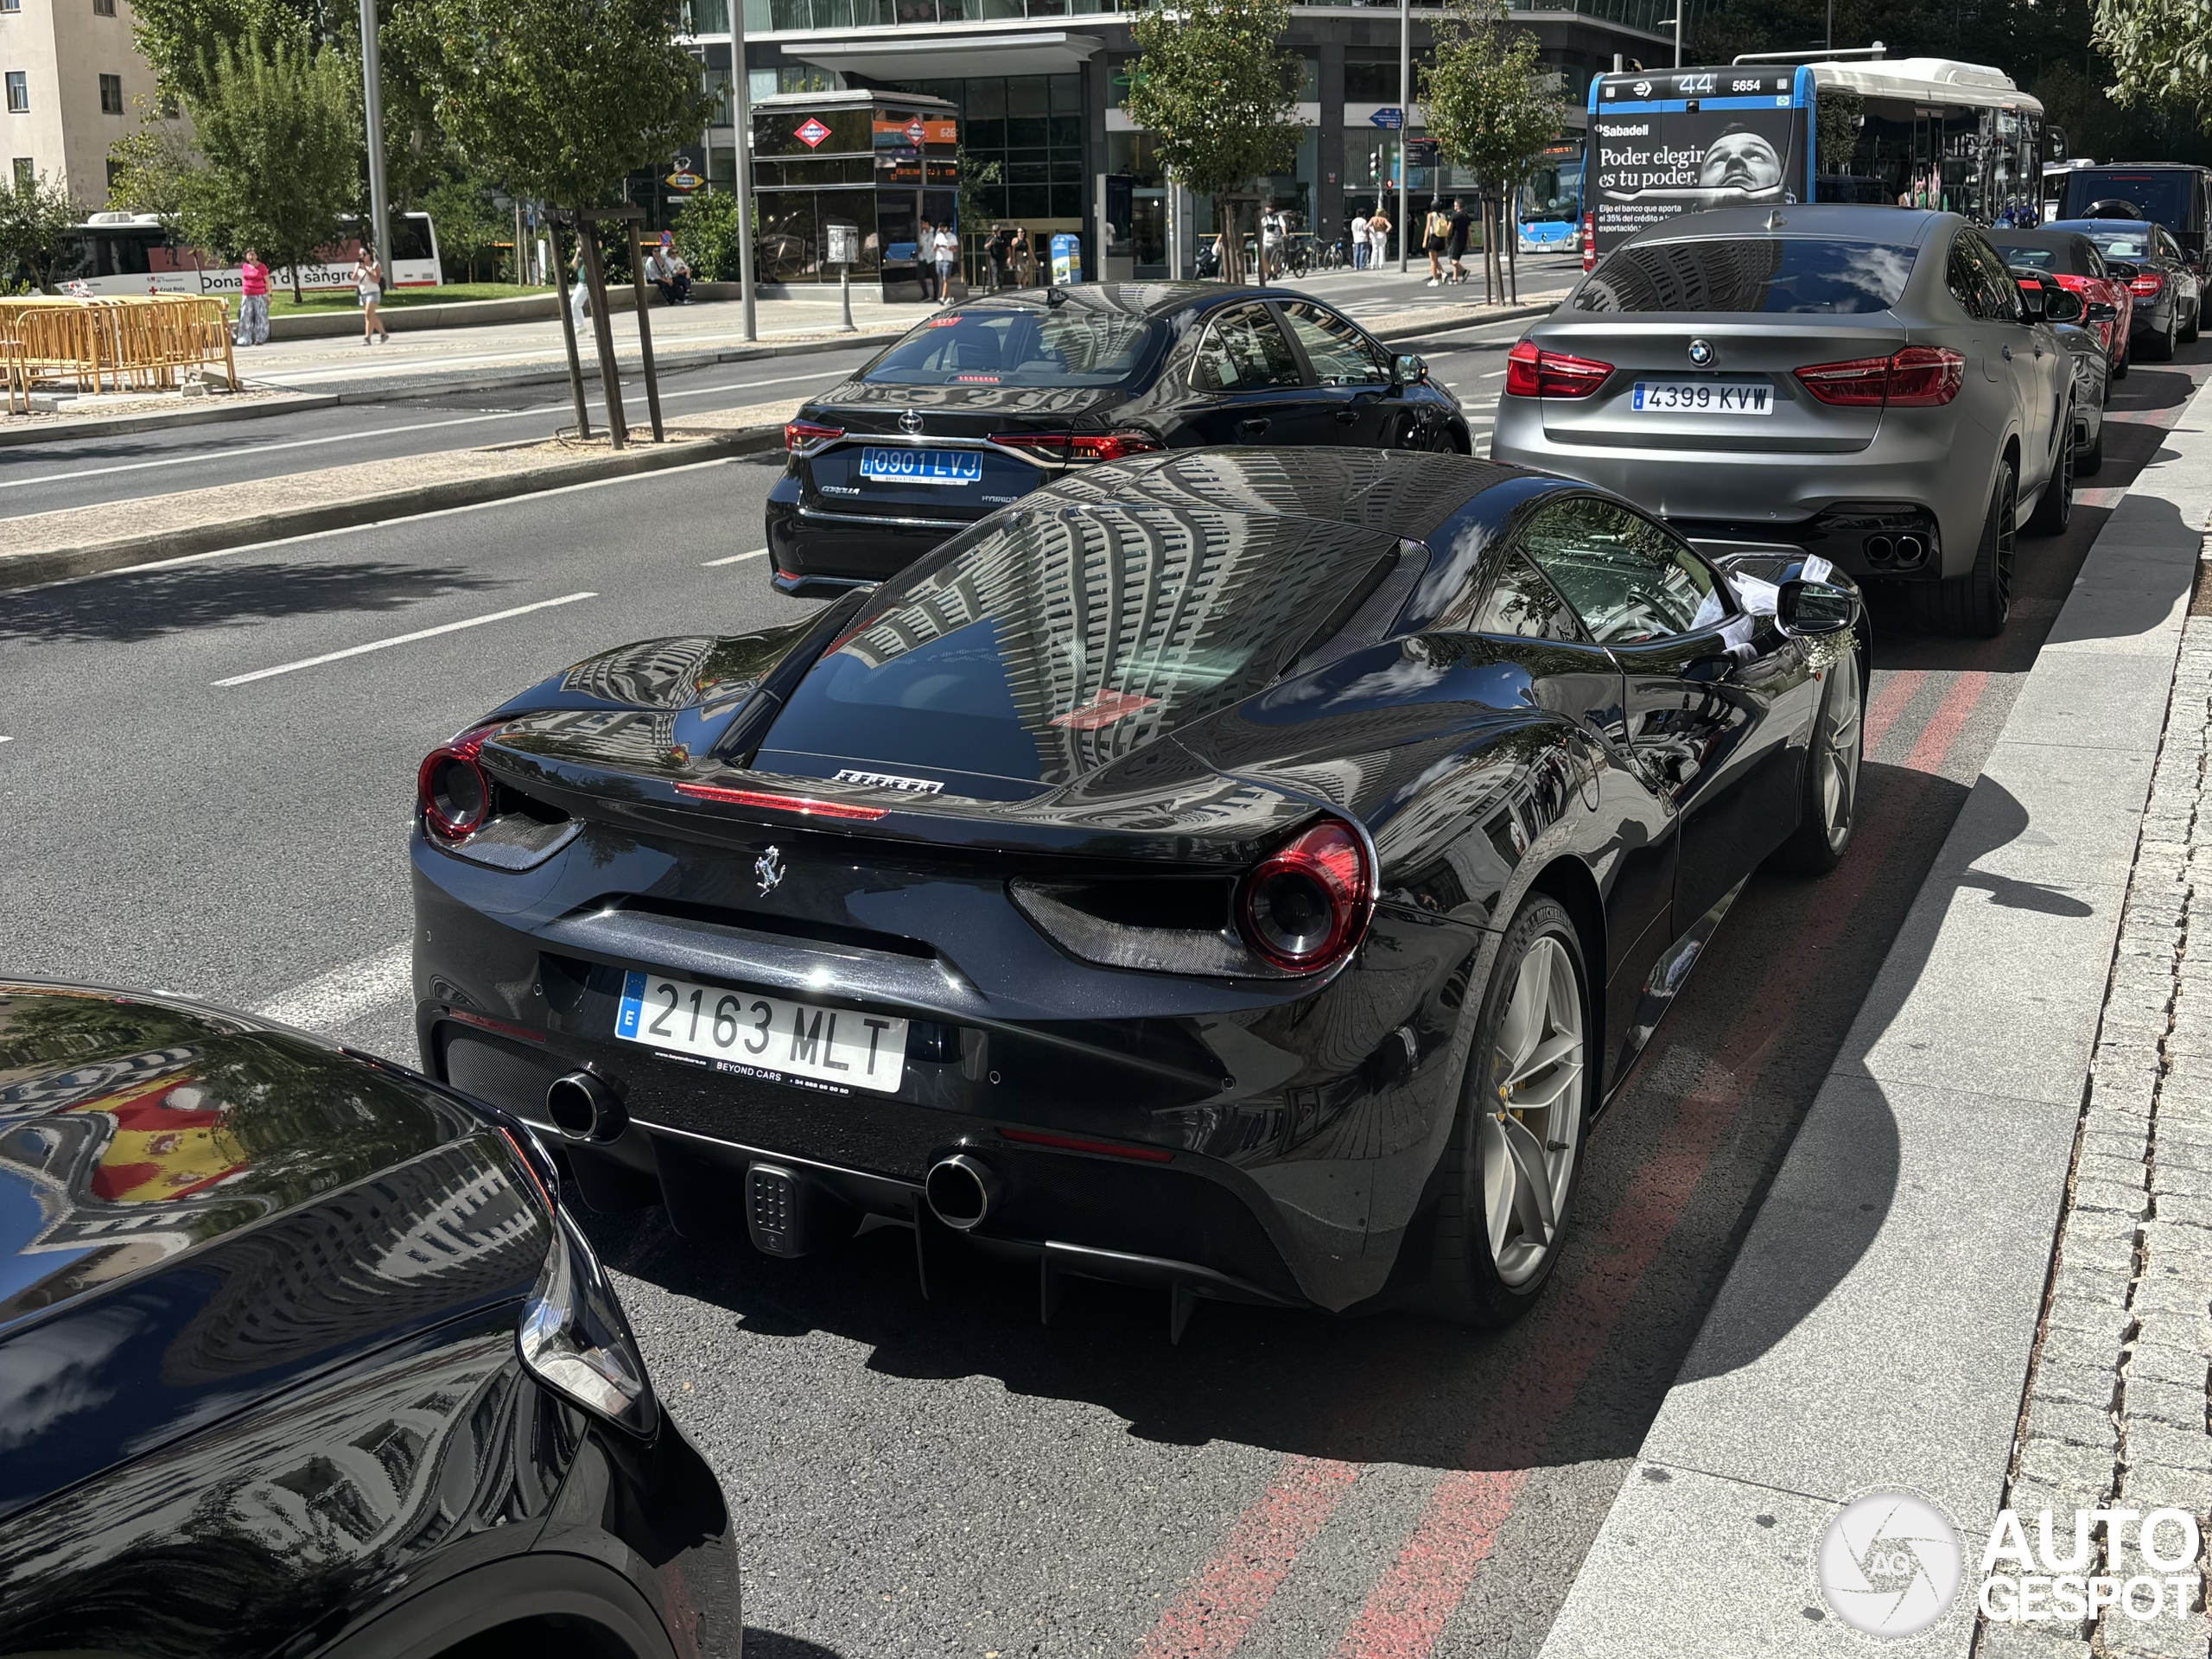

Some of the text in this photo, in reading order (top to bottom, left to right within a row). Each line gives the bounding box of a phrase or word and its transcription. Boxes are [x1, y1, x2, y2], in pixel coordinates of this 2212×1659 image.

[1679, 73, 1761, 93] 44 5654
[804, 128, 822, 137] Metro
[1602, 124, 1649, 137] Sabadell
[1600, 145, 1705, 168] Poder elegir
[1599, 166, 1698, 188] es tu poder.
[1599, 204, 1613, 213] Elijo
[1658, 205, 1681, 213] aporta
[304, 270, 353, 283] sangre
[1649, 385, 1710, 408] 4399
[1719, 387, 1768, 410] KVW
[874, 451, 925, 474] 0901
[933, 453, 976, 476] LVJ
[821, 486, 861, 495] COROLLA
[624, 983, 890, 1076] E 2163 MLT
[715, 1062, 754, 1077] BEYOND
[756, 1068, 782, 1082] CARS
